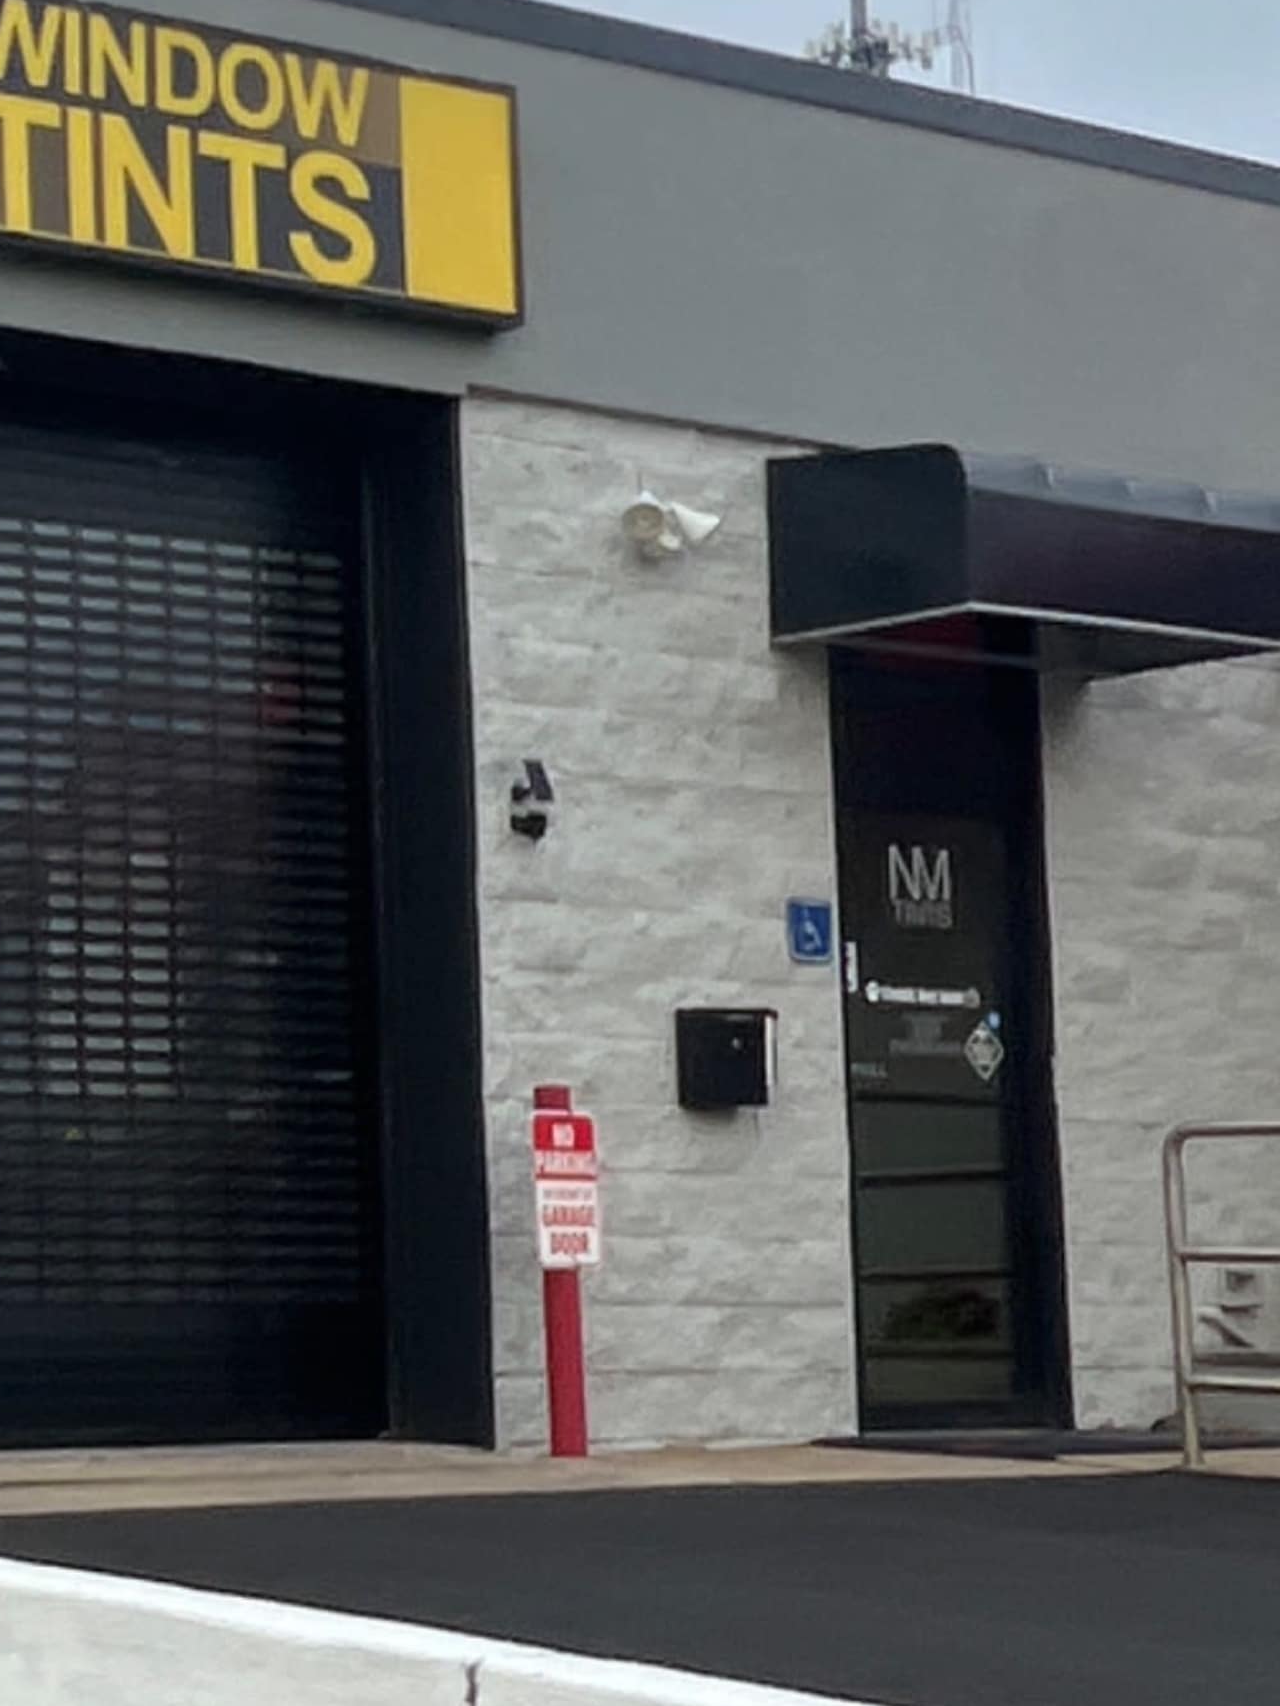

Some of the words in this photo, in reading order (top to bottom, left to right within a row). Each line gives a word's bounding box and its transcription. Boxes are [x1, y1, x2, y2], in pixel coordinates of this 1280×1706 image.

[889, 843, 952, 901] NM
[552, 1122, 575, 1148] NO
[542, 1204, 595, 1227] GARAGE
[550, 1231, 589, 1255] DOOR
